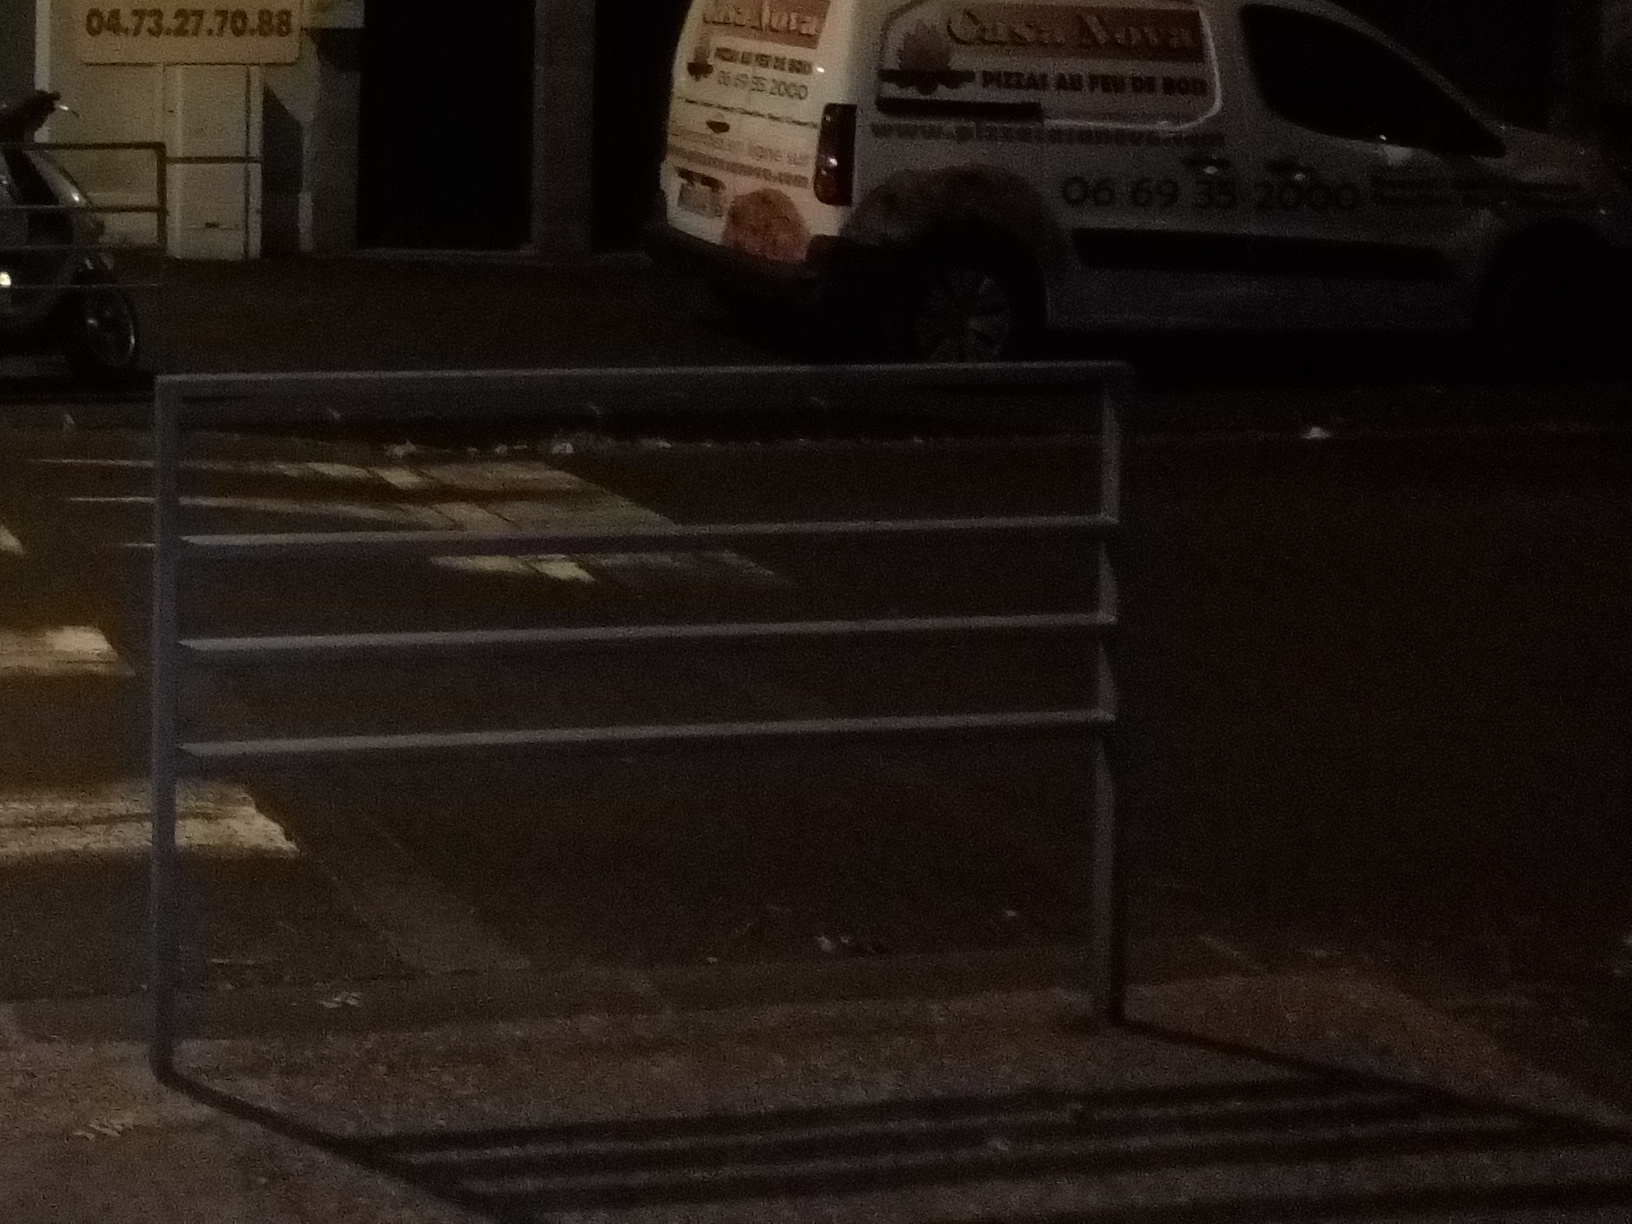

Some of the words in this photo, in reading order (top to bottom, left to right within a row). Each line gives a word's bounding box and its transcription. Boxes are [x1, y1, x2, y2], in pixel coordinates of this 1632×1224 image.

[85, 8, 293, 38] 04.73.27.70.88
[947, 8, 1065, 47] Casa
[1074, 11, 1199, 50] Nova
[1061, 175, 1117, 207] 06
[1130, 176, 1180, 209] 69
[1254, 178, 1360, 212] 2000
